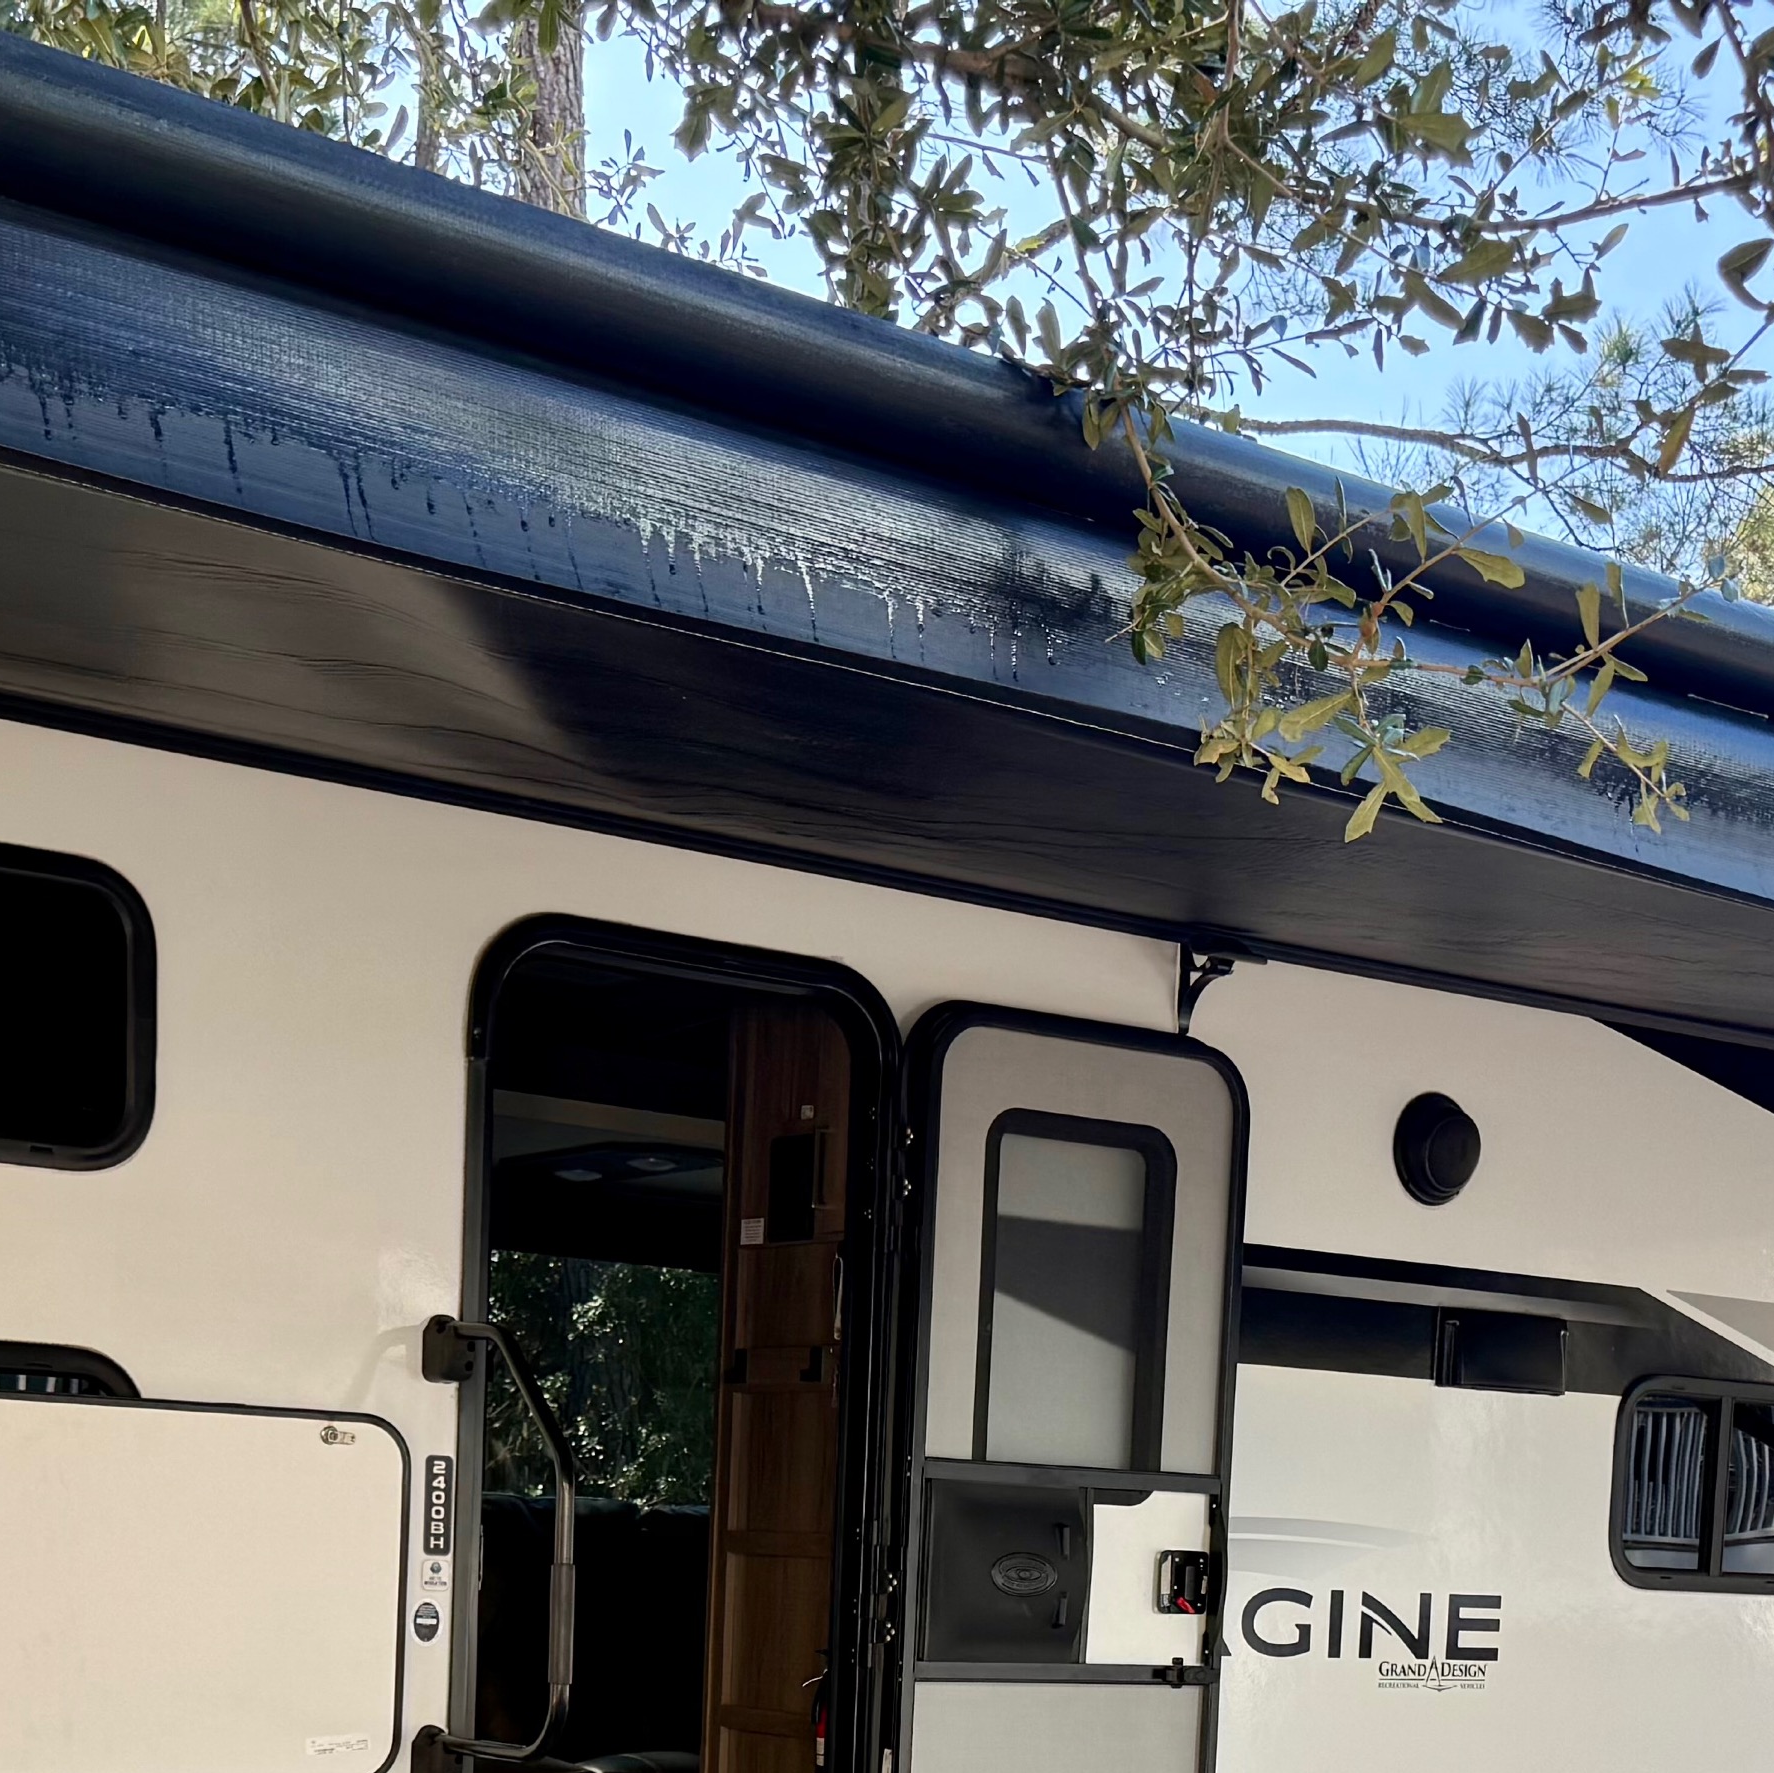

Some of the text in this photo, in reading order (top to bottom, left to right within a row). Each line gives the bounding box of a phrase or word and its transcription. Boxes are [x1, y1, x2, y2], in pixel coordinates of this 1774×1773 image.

[430, 1460, 446, 1549] 2400BH
[1221, 1587, 1502, 1661] GINE
[1378, 1661, 1487, 1678] GRAND DESIGN
